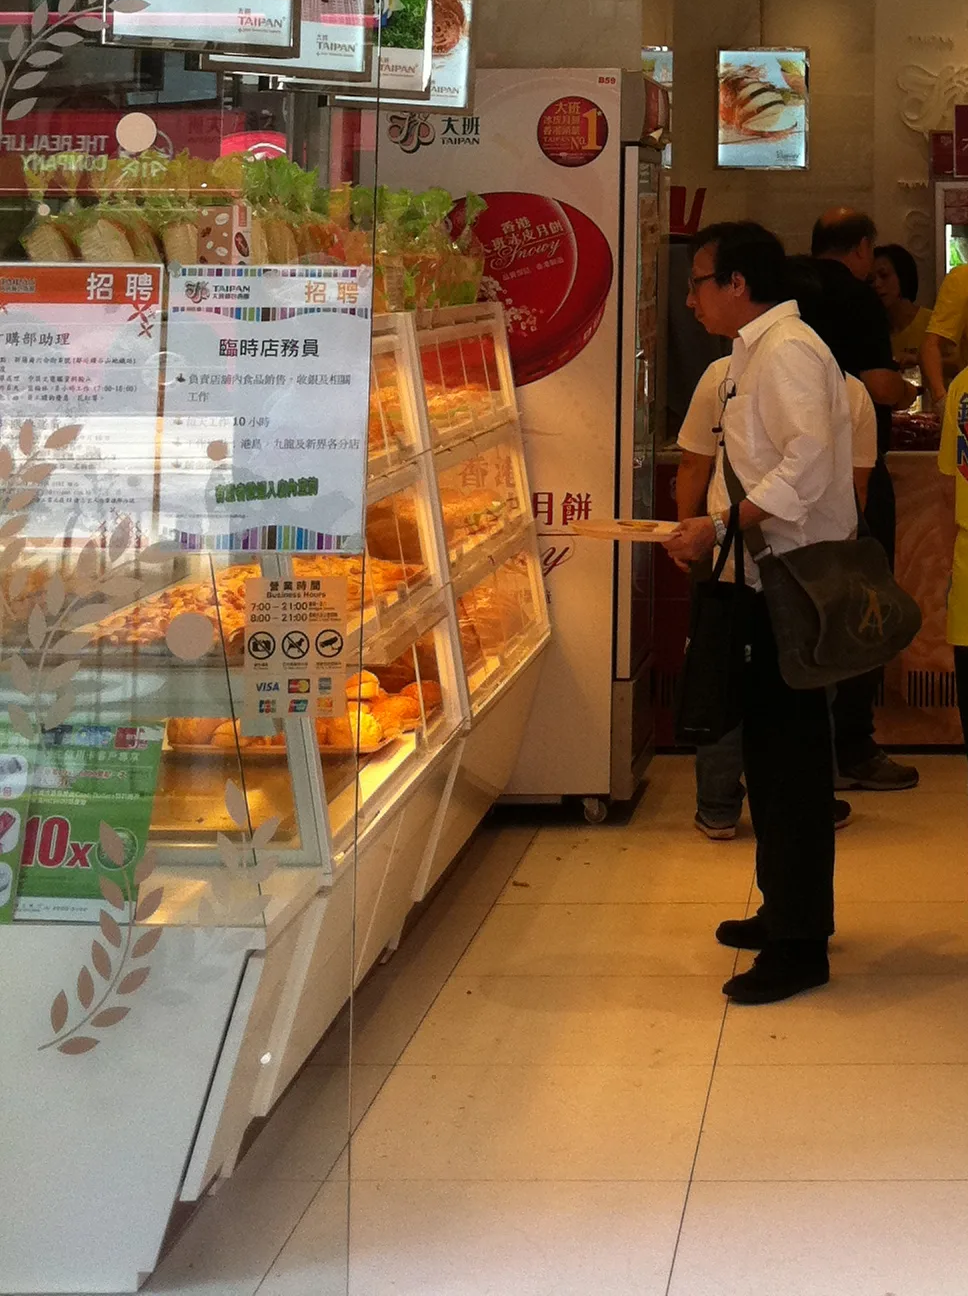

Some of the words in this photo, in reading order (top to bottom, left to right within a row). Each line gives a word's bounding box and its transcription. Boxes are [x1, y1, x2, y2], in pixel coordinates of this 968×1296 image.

[237, 16, 283, 28] TAIPAN
[316, 41, 357, 53] TAIPAN
[431, 85, 460, 95] AIPAN
[555, 102, 581, 115] 大班
[440, 116, 480, 136] 大班
[441, 137, 480, 145] TAIPAN
[501, 216, 532, 234] 香港
[490, 238, 561, 271] Snowy
[86, 271, 153, 301] 招聘
[304, 281, 360, 304] 招聘
[219, 339, 320, 358] 臨時店務員
[188, 392, 210, 403] 工作
[233, 417, 246, 427] 10
[270, 580, 321, 591] 營業時間
[303, 591, 326, 599] Hours
[251, 603, 271, 611] 7:00
[250, 614, 271, 622] 8:00
[256, 682, 280, 691] VISA
[21, 815, 96, 869] 10x
